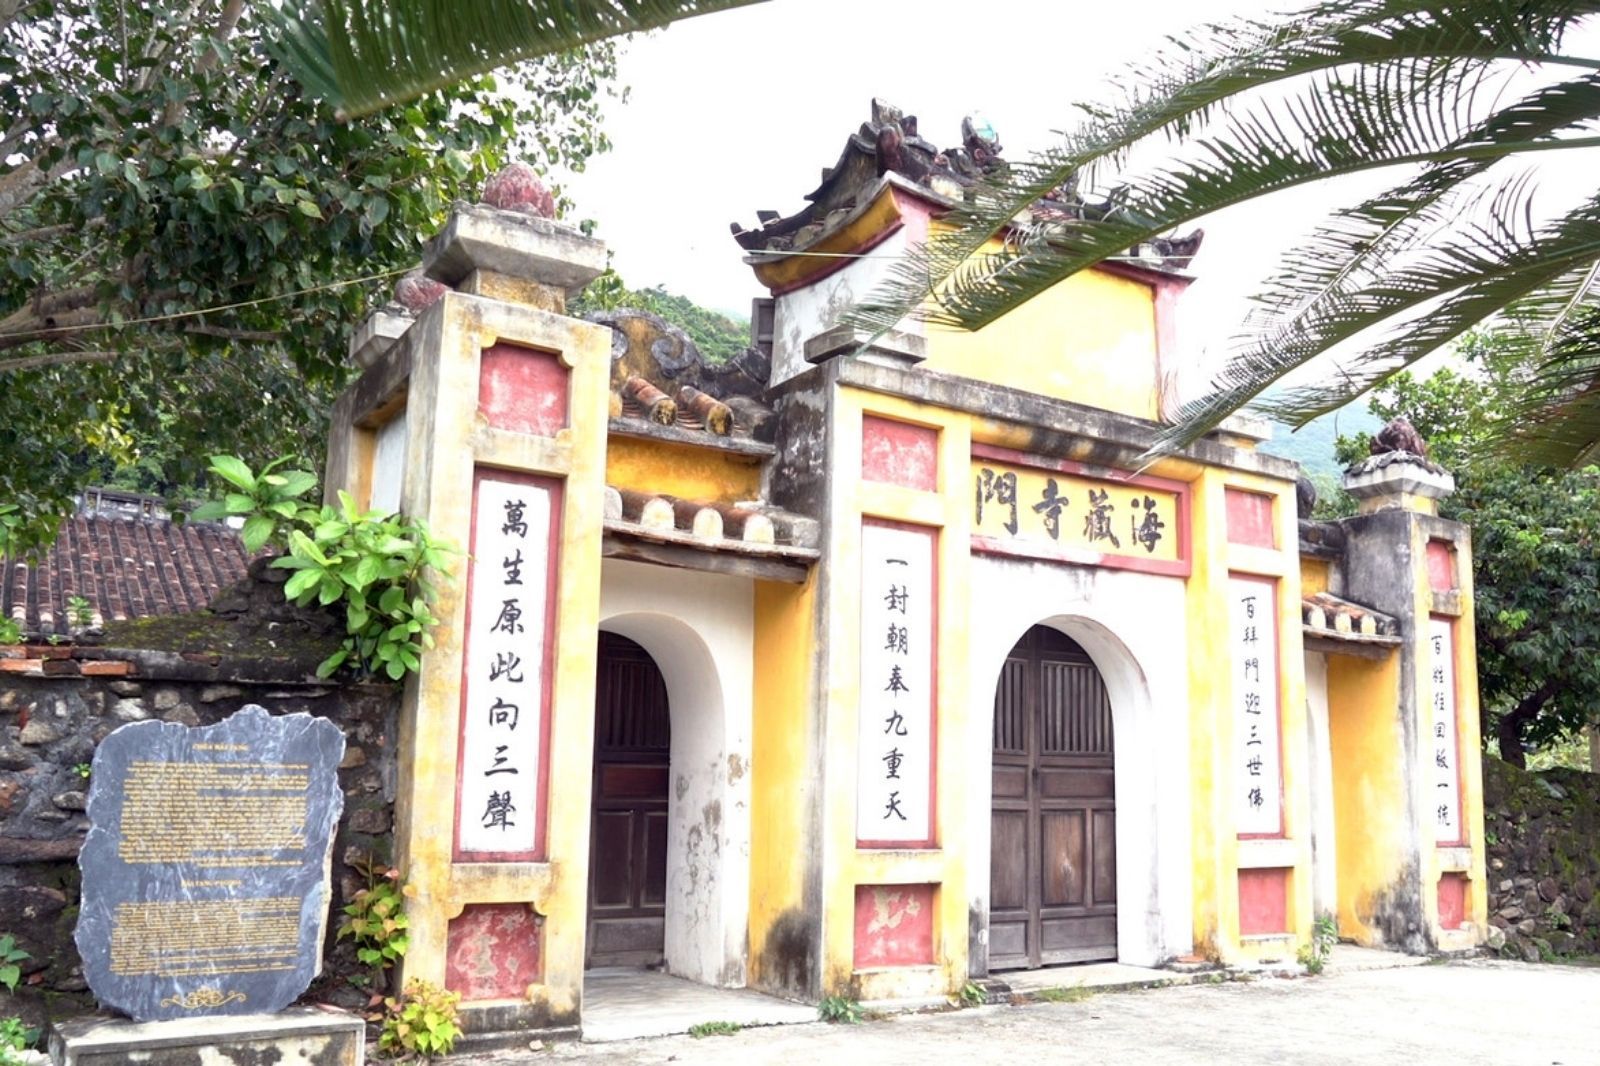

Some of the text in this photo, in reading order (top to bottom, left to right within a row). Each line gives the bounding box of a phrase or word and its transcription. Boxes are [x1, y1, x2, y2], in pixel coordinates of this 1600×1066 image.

[481, 499, 529, 832] 萬生原此向三聲
